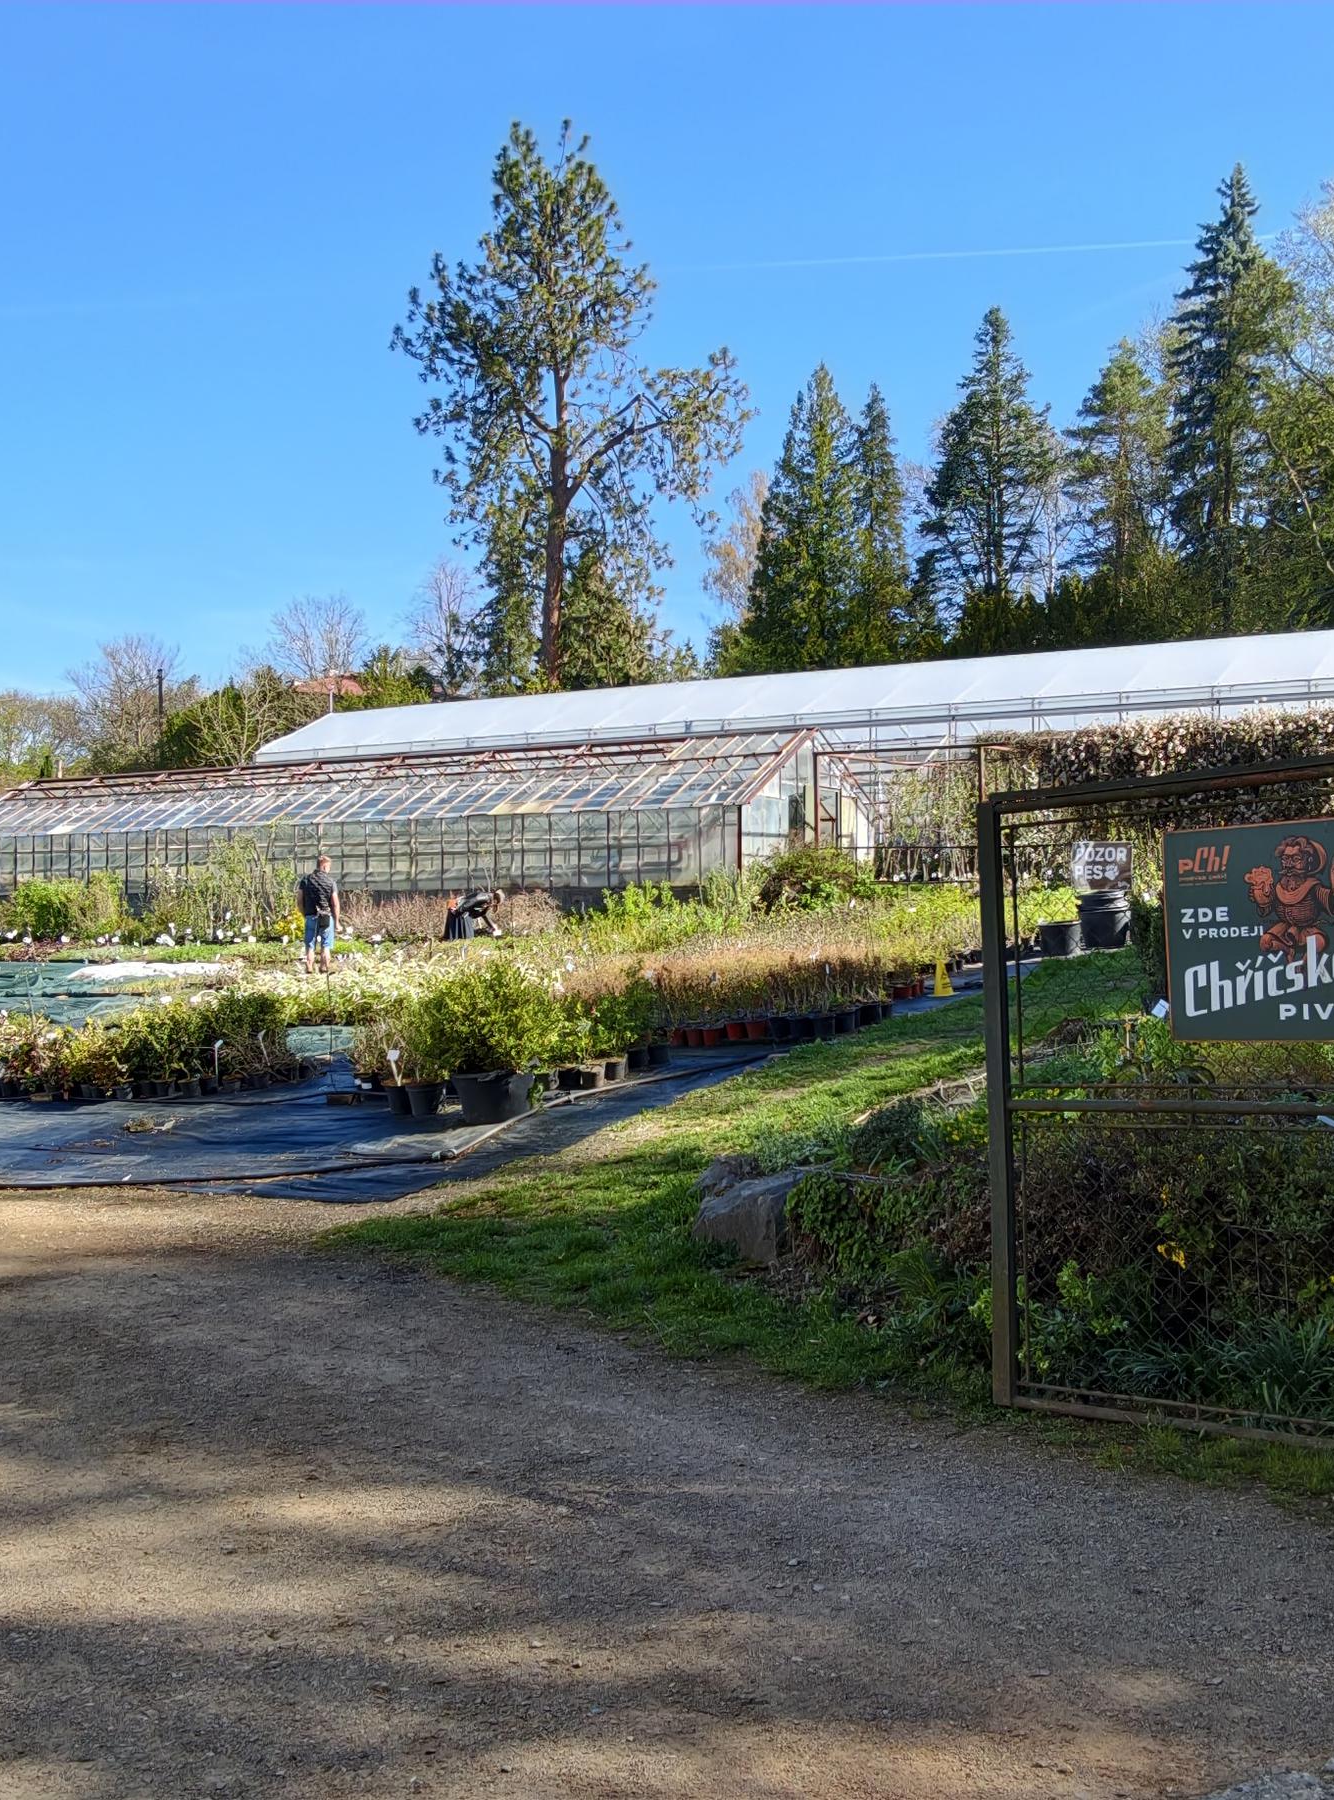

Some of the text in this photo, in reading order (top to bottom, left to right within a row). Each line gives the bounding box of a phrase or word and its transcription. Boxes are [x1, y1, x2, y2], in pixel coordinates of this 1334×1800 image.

[1074, 846, 1127, 863] POZOR
[1074, 865, 1103, 880] PES
[1180, 906, 1230, 924] ZDE
[1182, 925, 1264, 940] V PRODEJI
